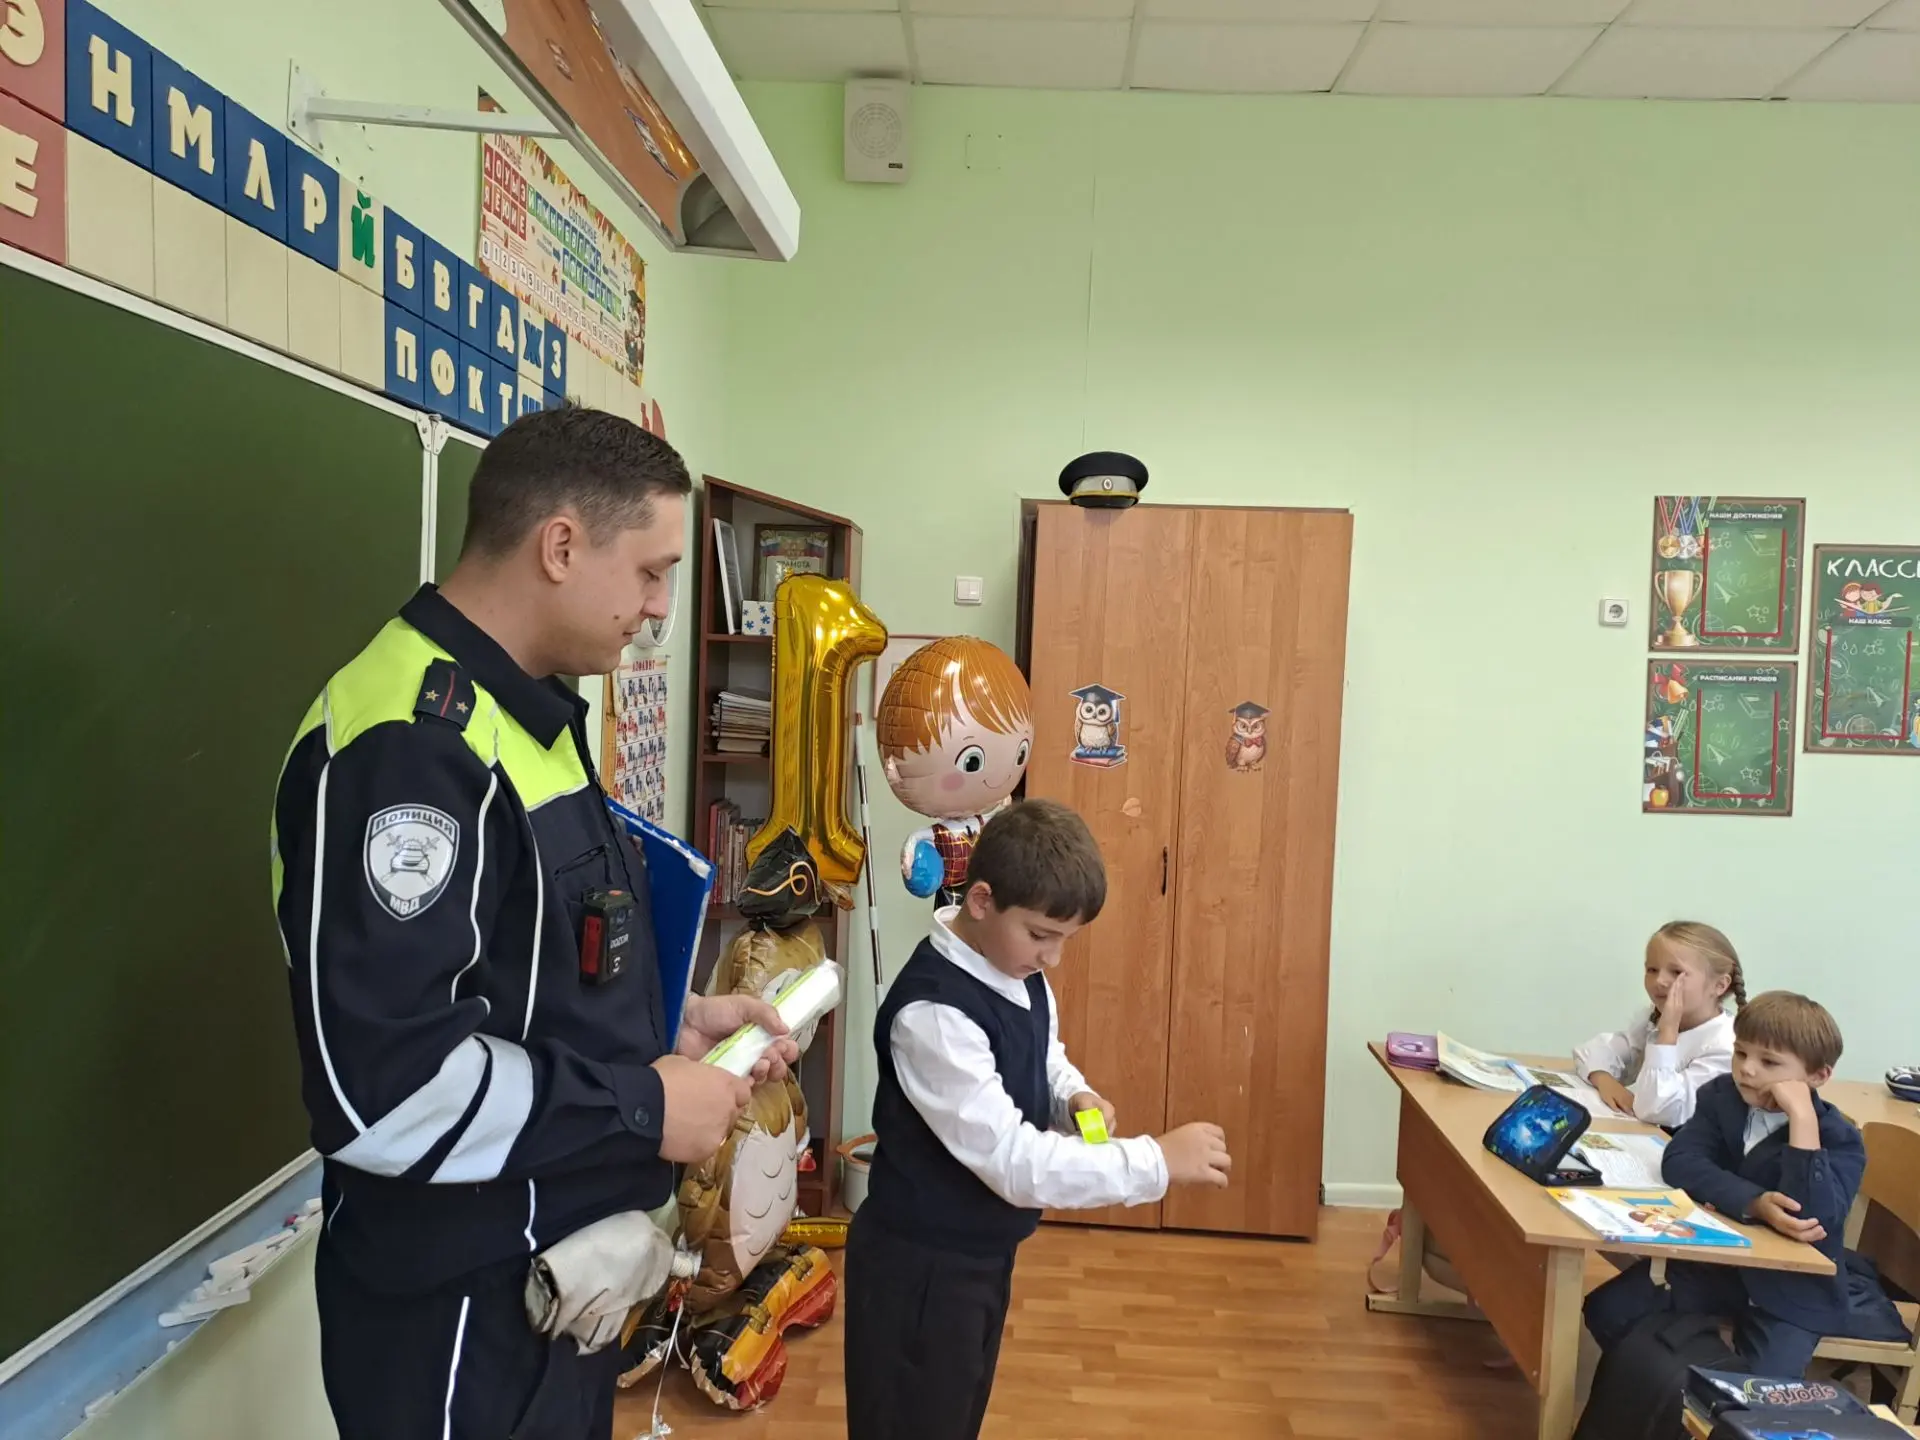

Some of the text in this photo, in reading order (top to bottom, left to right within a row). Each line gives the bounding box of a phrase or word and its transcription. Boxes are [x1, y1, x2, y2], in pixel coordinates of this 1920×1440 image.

[0, 0, 44, 66] Э
[89, 34, 135, 127] Н
[168, 86, 215, 175] М
[244, 138, 275, 211] Л
[302, 173, 327, 234] Р
[351, 189, 375, 268] Й
[396, 235, 415, 289] Б
[433, 260, 450, 311] В
[468, 283, 484, 329] Г
[497, 305, 515, 354] Д
[523, 319, 543, 369] Ж
[551, 340, 562, 379] З
[0, 124, 39, 218] Е
[396, 327, 417, 383] П
[431, 348, 455, 396] Ф
[468, 365, 484, 414] К
[499, 382, 513, 423] Т
[1826, 557, 1920, 579] КЛАСС
[1700, 674, 1747, 682] РАСПИСАНИЕ
[375, 810, 453, 836] ПОЛИЦИЯ
[389, 894, 420, 916] МВД
[1767, 1382, 1838, 1405] sports
